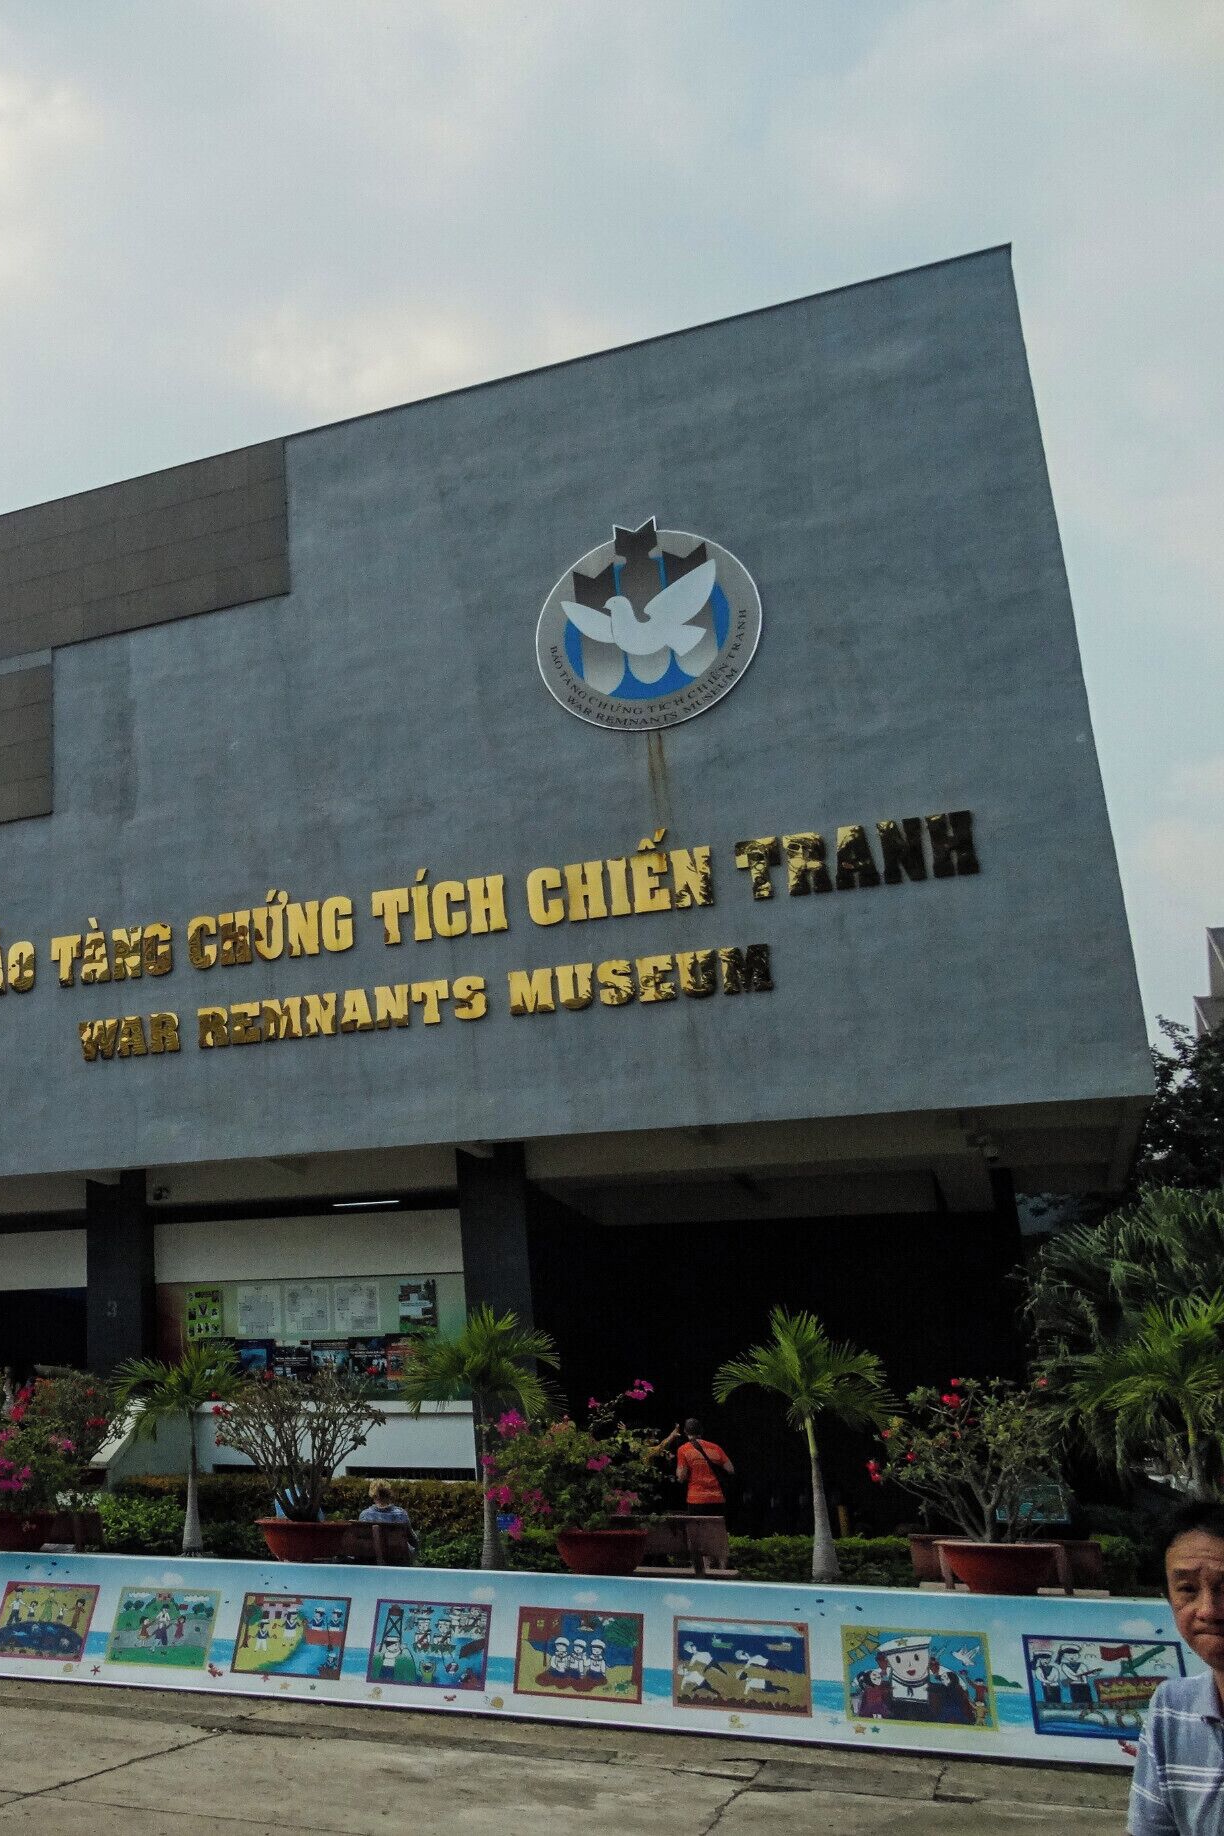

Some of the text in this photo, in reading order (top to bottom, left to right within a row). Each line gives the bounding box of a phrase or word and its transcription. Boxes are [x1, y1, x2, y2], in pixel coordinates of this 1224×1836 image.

[567, 696, 593, 717] WAR
[50, 917, 173, 987] TÀNG
[188, 889, 354, 970] CHỨNG
[371, 867, 509, 946] TÍCH
[526, 827, 714, 926] CHIẾN
[735, 809, 980, 900] TRANH
[79, 943, 774, 1062] WAR REMNANTS MUSEUM
